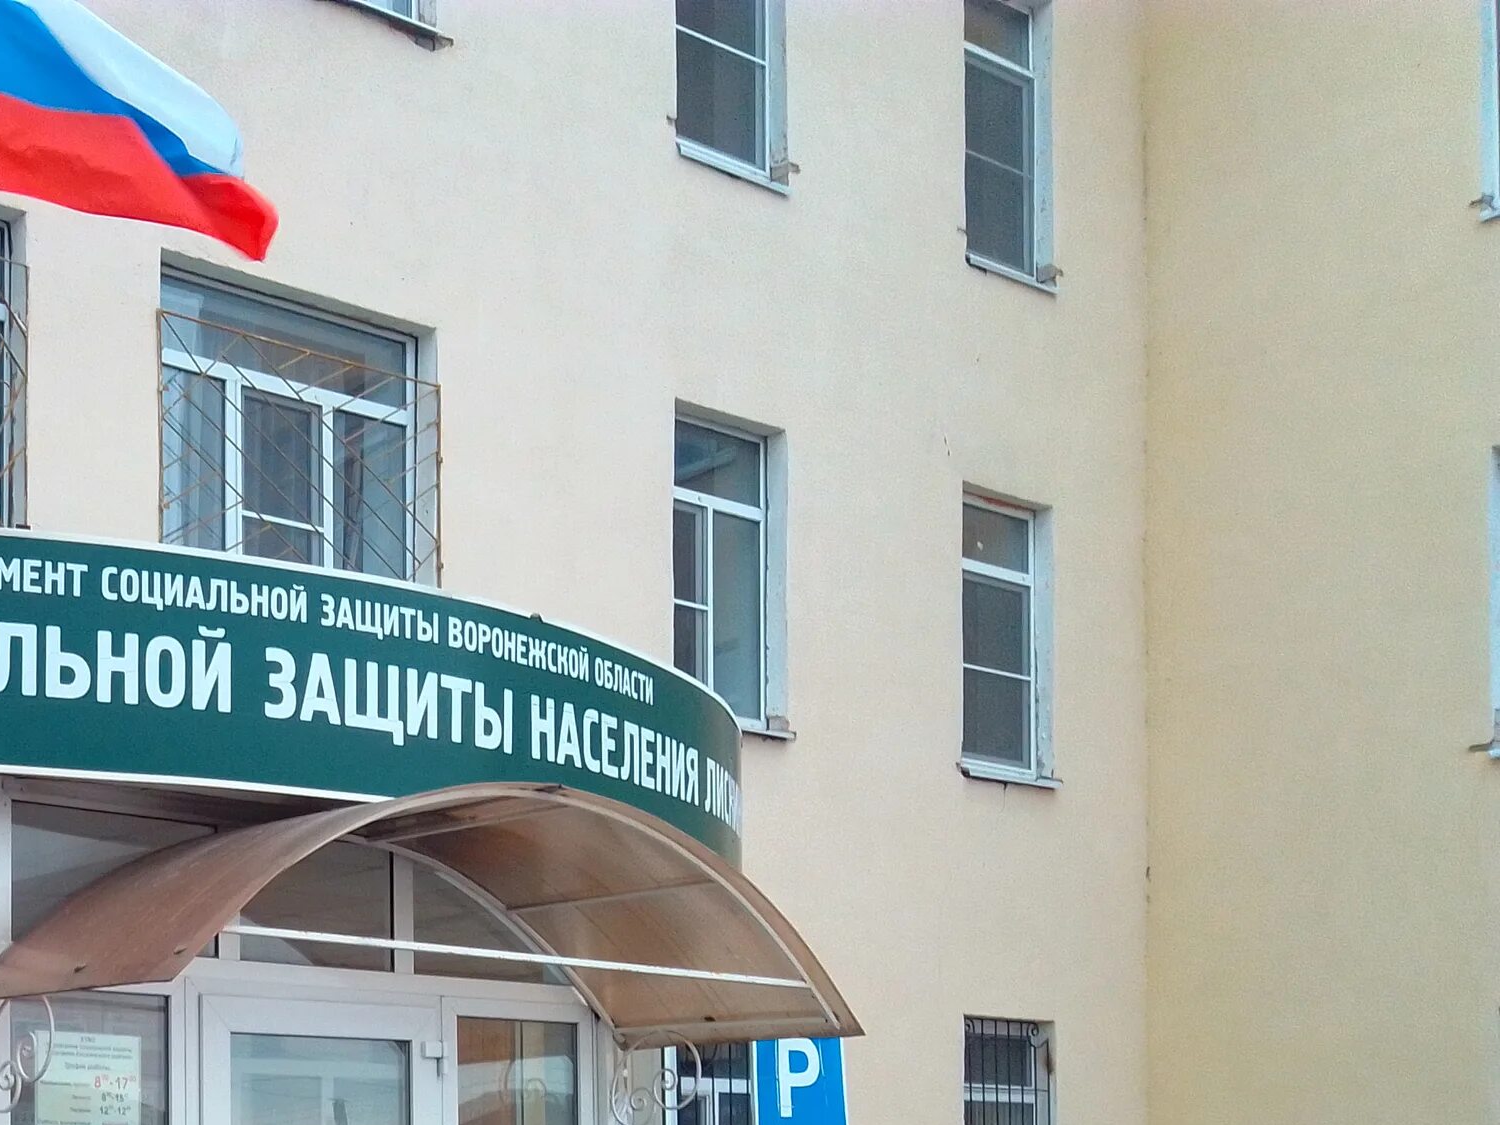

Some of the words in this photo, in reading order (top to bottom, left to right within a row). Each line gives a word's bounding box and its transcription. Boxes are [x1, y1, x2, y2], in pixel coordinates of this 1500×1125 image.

[101, 566, 307, 623] СОЦИАЛЬНОЙ
[320, 593, 439, 644] ЗАЩИТЫ
[448, 616, 589, 682] ВОРОНЕЖСКОЙ
[594, 657, 654, 706] ОБЛАСТИ
[264, 647, 513, 755] ЗАЩИТЫ
[530, 694, 699, 807] НАСЕЛЕНИЯ
[778, 1037, 820, 1118] P
